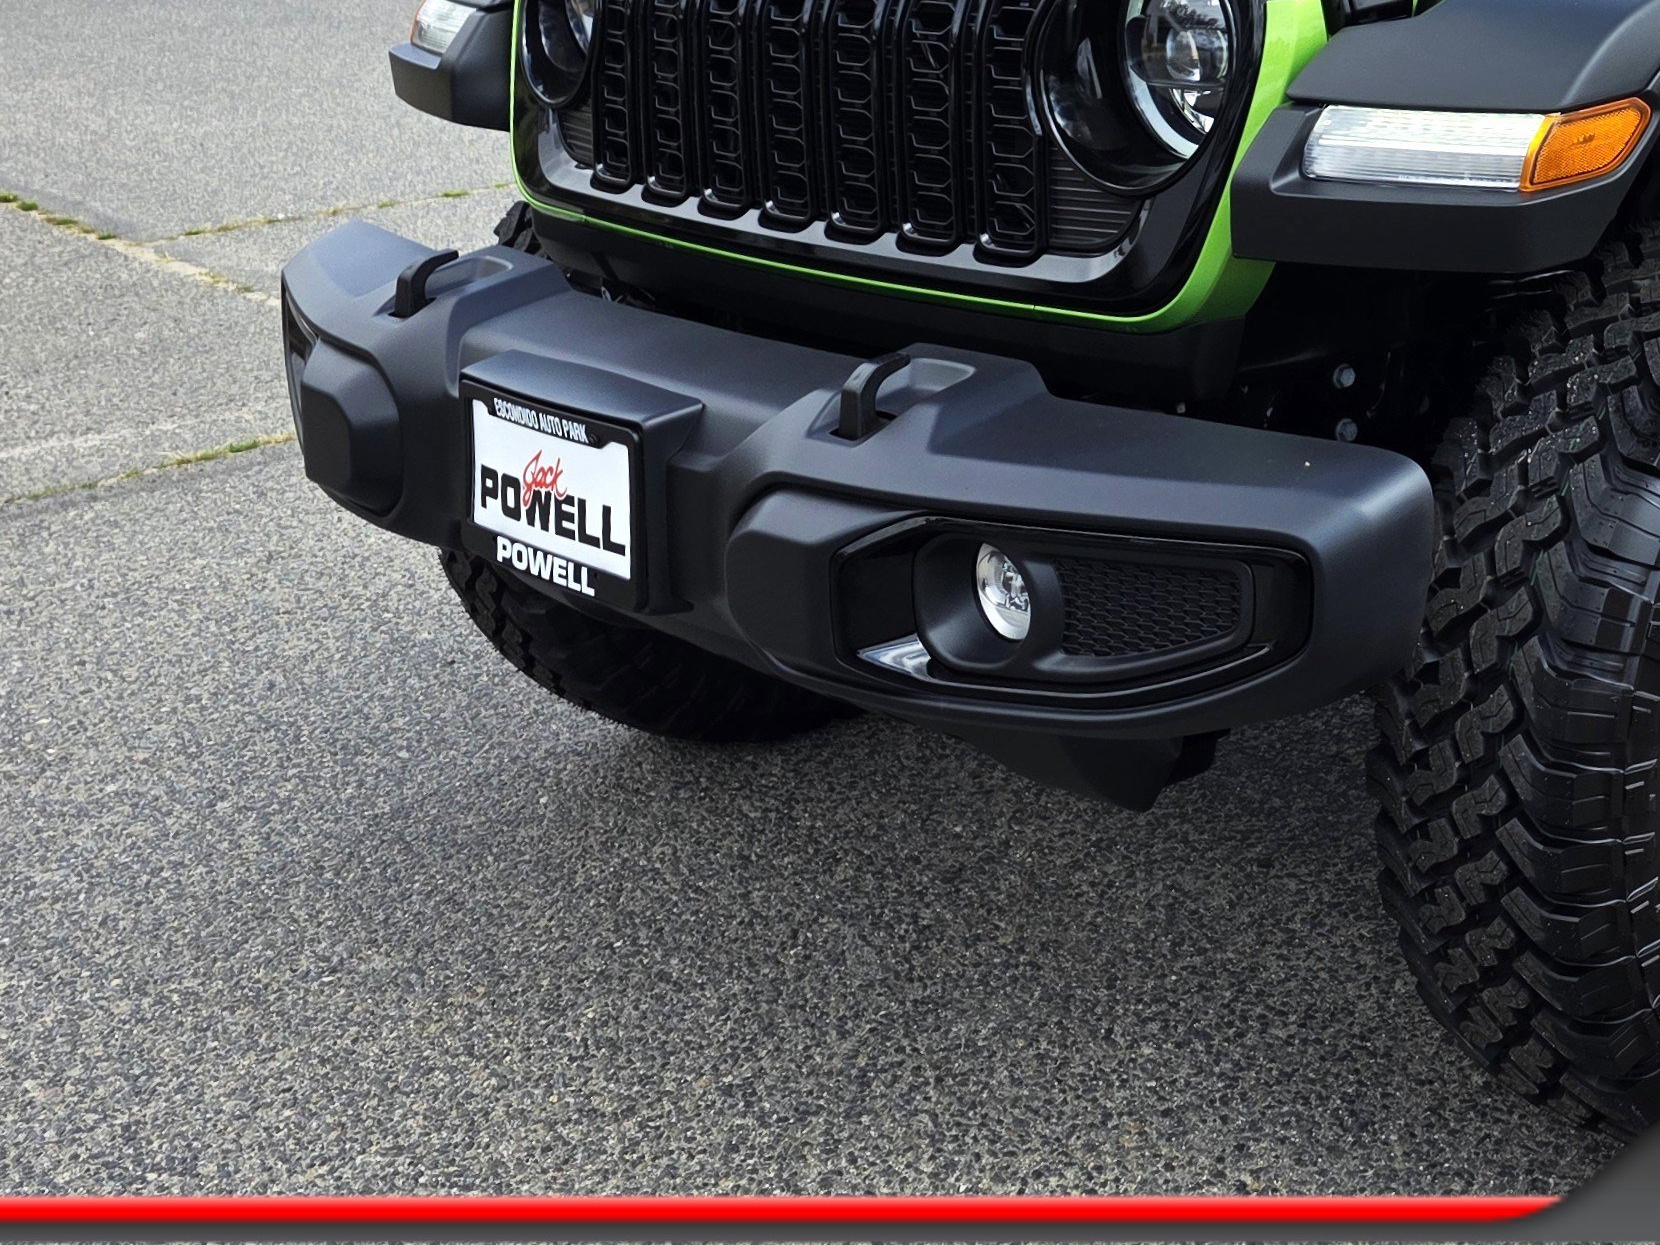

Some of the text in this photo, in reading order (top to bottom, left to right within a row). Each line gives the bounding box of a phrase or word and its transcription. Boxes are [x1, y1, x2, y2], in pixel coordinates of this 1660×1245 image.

[493, 397, 589, 444] ESCONDIDO AUTO PARK
[522, 449, 568, 508] Jack
[480, 463, 626, 557] POWELL
[496, 535, 596, 597] POWELL
